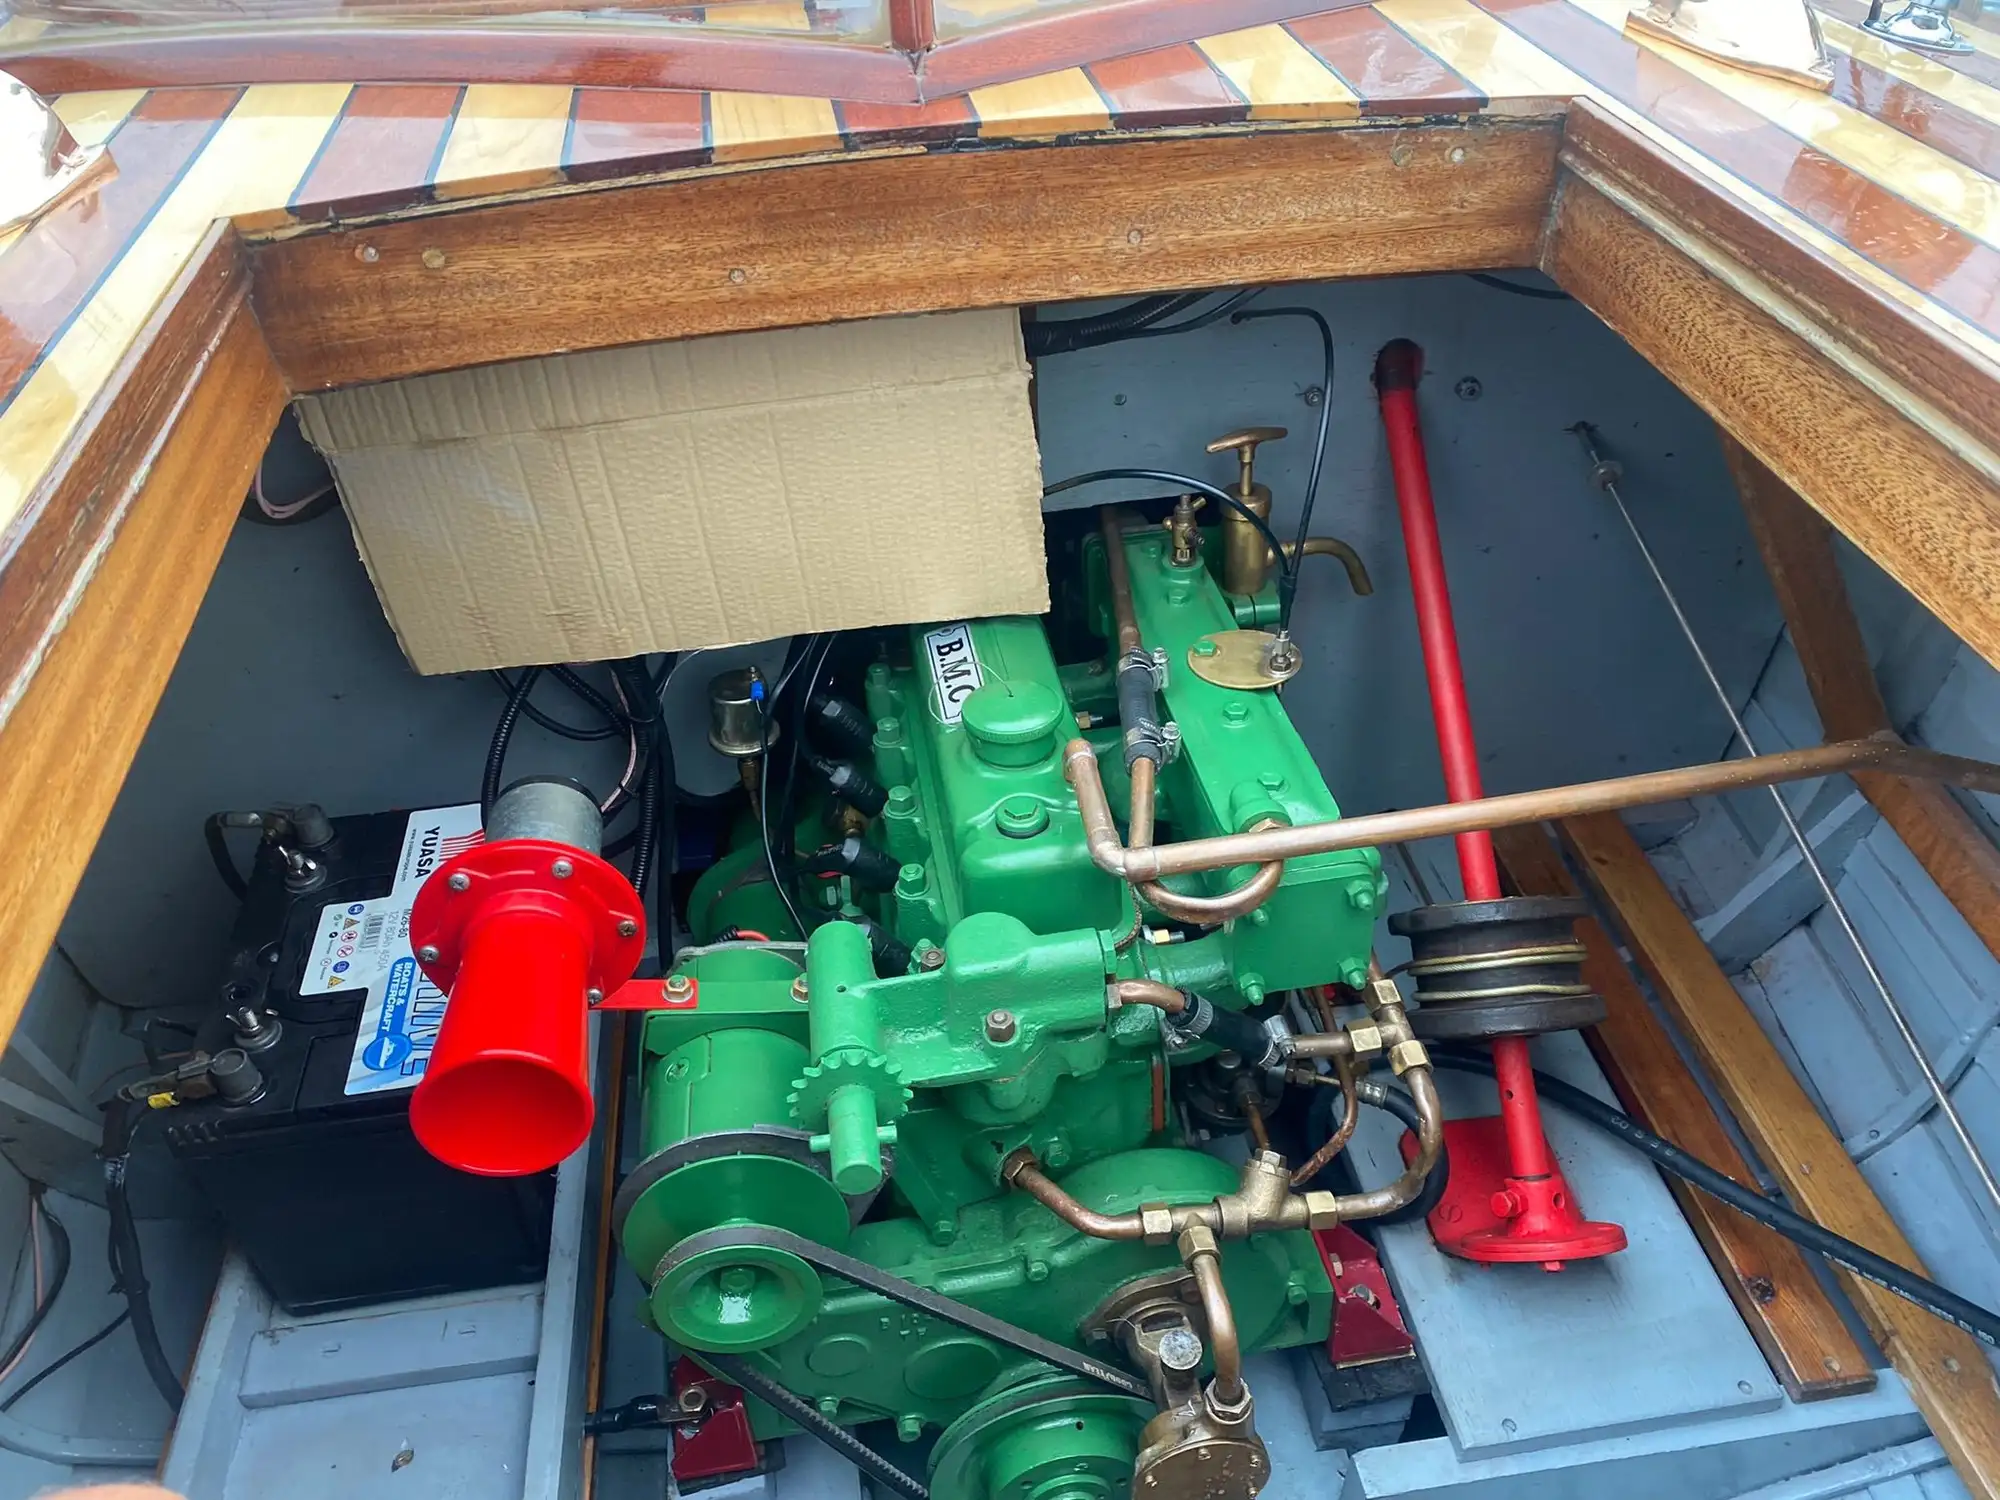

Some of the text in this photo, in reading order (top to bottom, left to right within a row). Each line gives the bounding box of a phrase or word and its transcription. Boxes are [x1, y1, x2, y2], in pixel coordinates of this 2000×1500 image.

[415, 826, 440, 879] YUASA
[382, 963, 404, 1032] WATERCRAFT
[396, 961, 413, 1006] BOATS &
